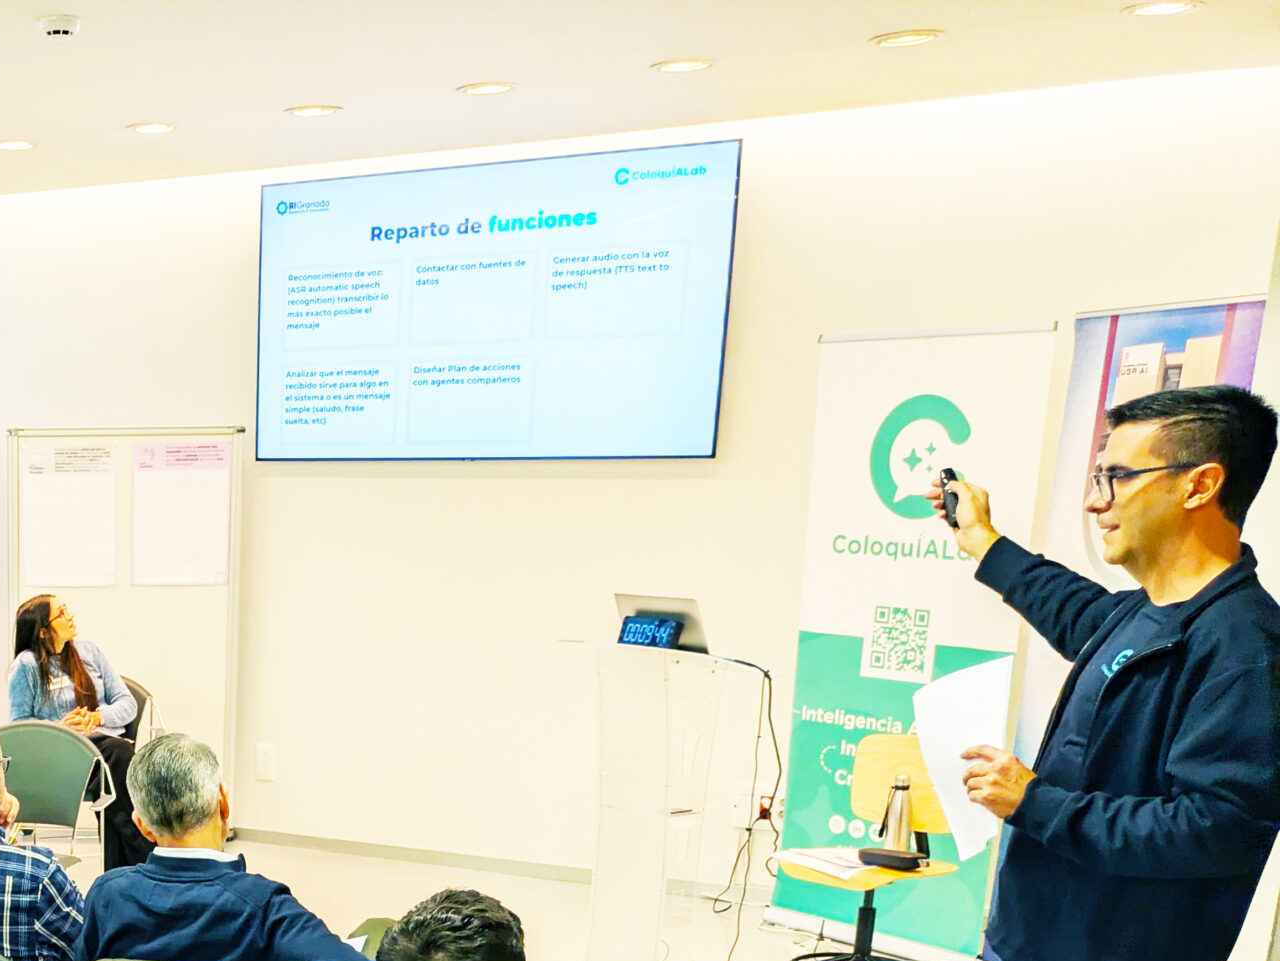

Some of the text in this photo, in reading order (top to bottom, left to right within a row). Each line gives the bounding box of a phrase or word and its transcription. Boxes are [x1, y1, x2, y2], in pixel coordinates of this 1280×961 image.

[370, 210, 598, 244] Reparto de funciones
[553, 250, 670, 264] Generar audio con la voz
[416, 259, 527, 274] Contactar con fuentes de
[552, 270, 564, 278] de
[566, 267, 612, 277] respuesta
[615, 265, 635, 275] (TTS
[637, 264, 657, 272] text
[288, 271, 353, 281] Reconocimiento
[355, 270, 365, 278] de
[415, 278, 440, 286] datos
[551, 281, 588, 291] speech)
[288, 281, 380, 295] (ASR automatic speech
[288, 296, 335, 307] recognition)
[337, 293, 380, 303] transcribir
[306, 309, 332, 317] exacto
[334, 307, 363, 317] posible
[287, 322, 320, 331] mensaje
[285, 368, 380, 379] Analizar que el mensaje
[414, 362, 521, 374] Diseñar Plan de acciones
[285, 382, 317, 390] recibido
[319, 381, 338, 389] sirve
[340, 381, 357, 389] para
[359, 380, 377, 389] algo
[430, 377, 465, 387] agentes
[467, 376, 521, 385] compañeros
[285, 394, 293, 402] el
[356, 391, 391, 401] mensaje
[285, 406, 311, 414] simple
[312, 405, 343, 414] (saludo,
[285, 417, 327, 425] suelta, etc)
[801, 705, 903, 734] Inteligencia
